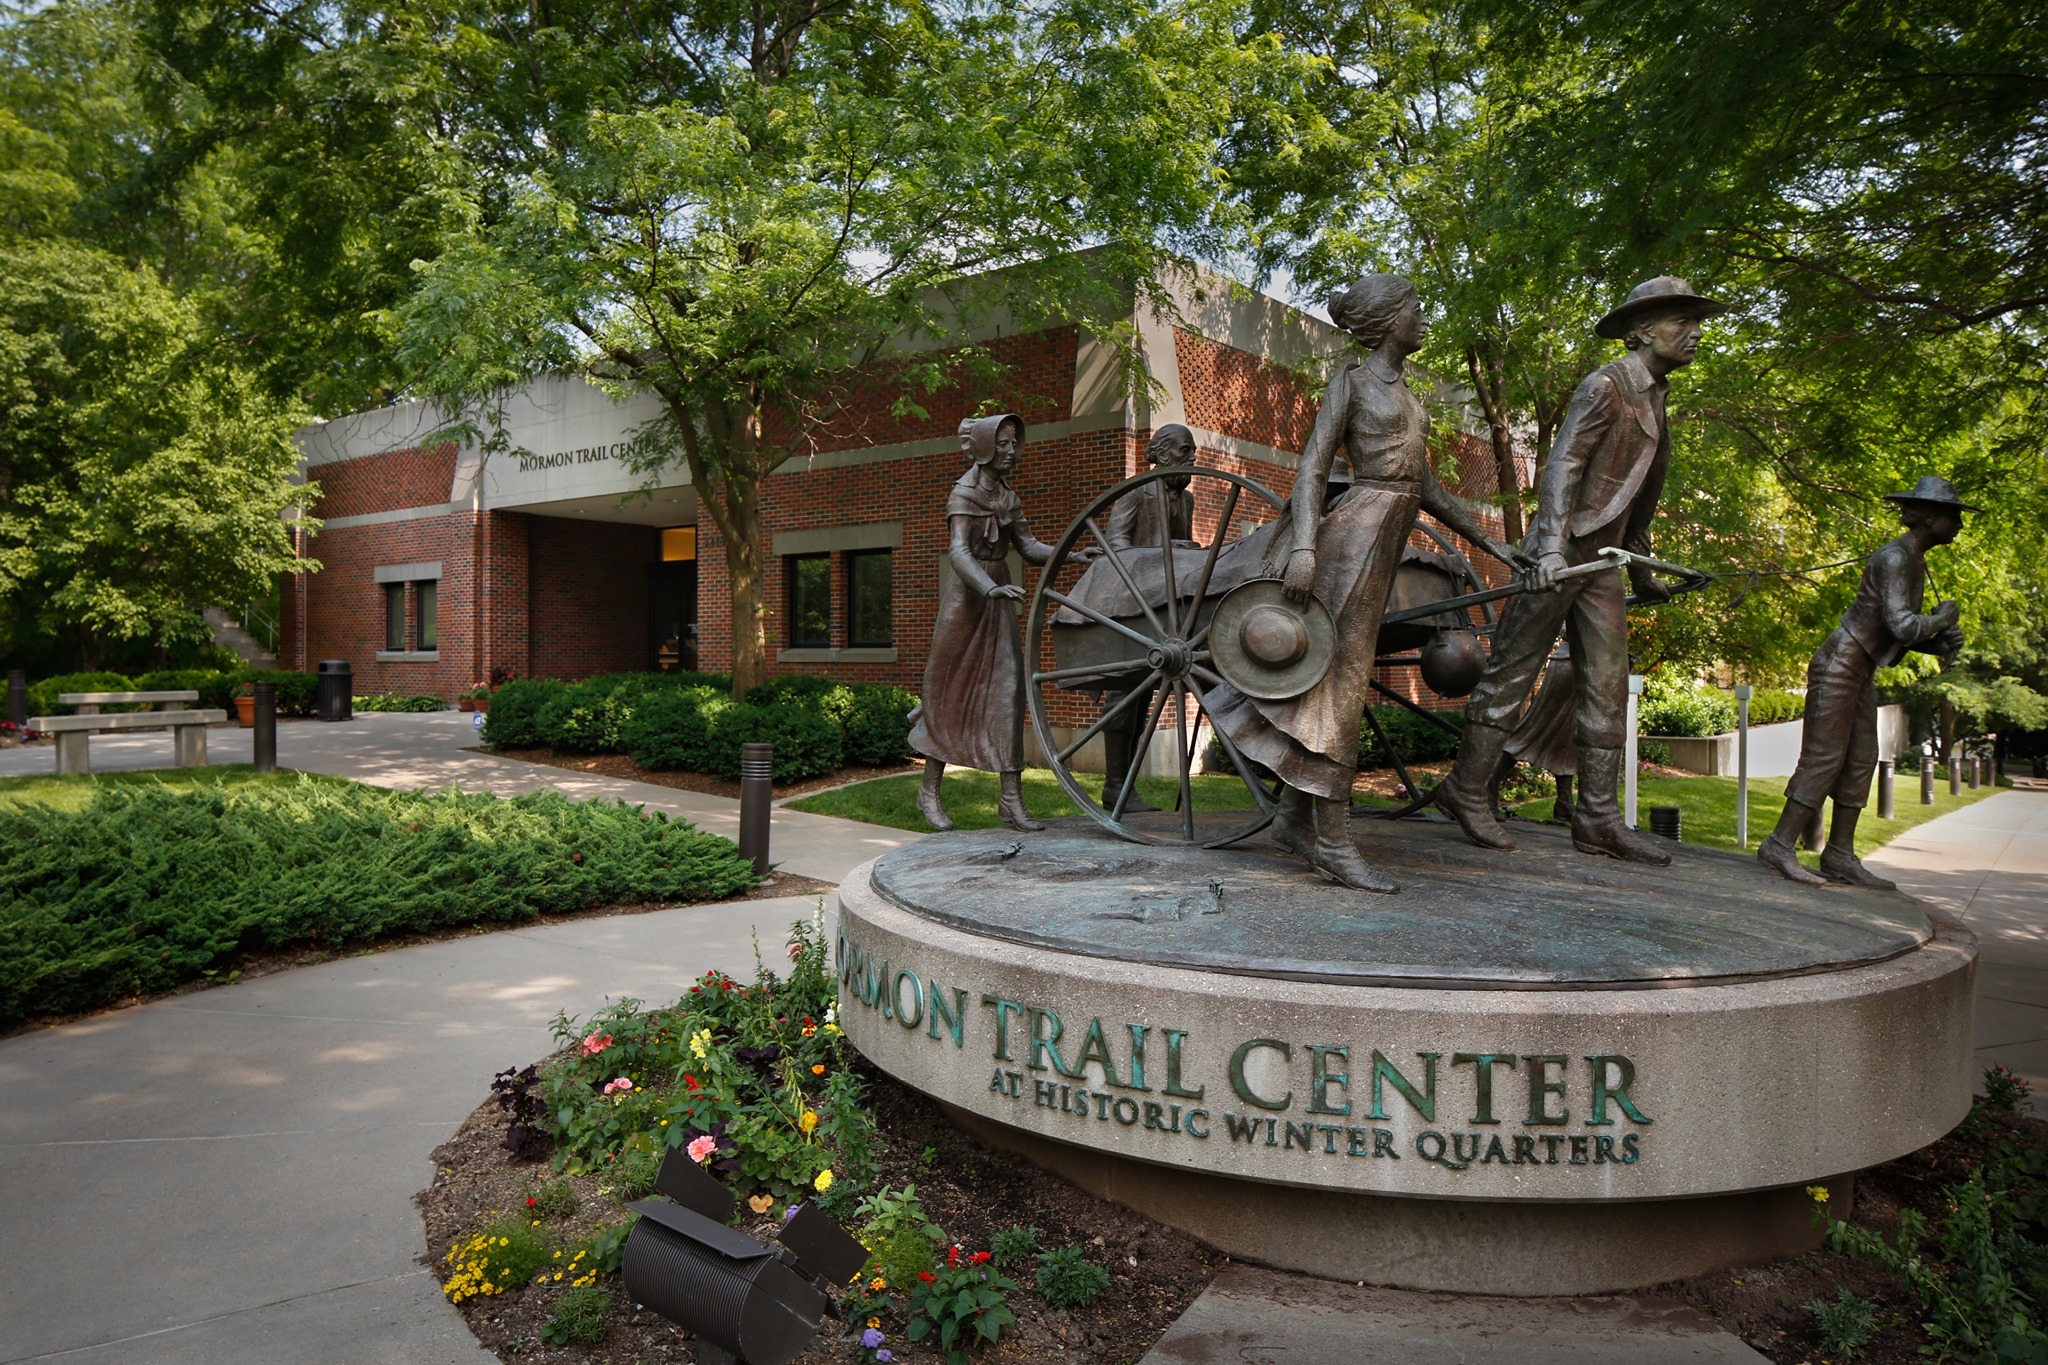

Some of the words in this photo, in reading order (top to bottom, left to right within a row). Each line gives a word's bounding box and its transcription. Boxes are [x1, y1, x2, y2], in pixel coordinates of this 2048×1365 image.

[519, 451, 573, 472] MORMON
[576, 446, 608, 463] TRAIL
[836, 919, 968, 1048] ORMON
[982, 993, 1205, 1099] TRAIL
[1229, 1038, 1654, 1126] CENTER
[990, 1067, 1024, 1099] AT
[1034, 1079, 1210, 1138] HISTORIC
[1224, 1113, 1401, 1160] WINTER
[1415, 1131, 1641, 1170] QUARTERS
